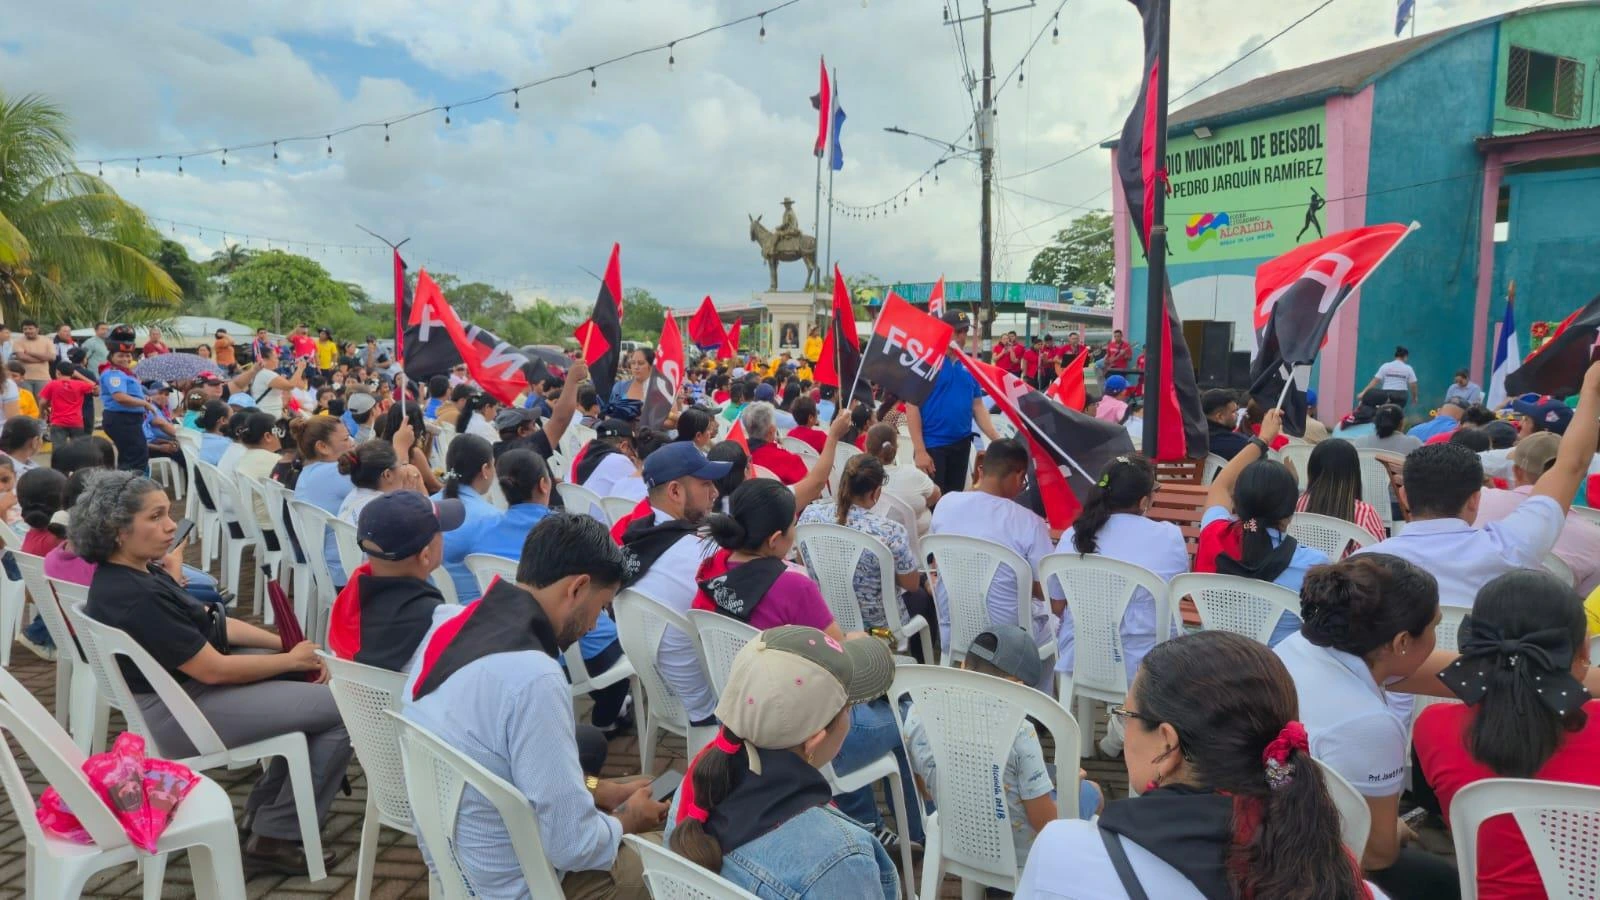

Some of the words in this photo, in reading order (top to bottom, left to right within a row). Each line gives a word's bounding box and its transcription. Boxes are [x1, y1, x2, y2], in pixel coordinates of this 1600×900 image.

[1185, 138, 1248, 173] MUNICIPAL
[1250, 134, 1266, 160] DE
[1270, 123, 1323, 157] BEISBOL
[1173, 177, 1209, 199] PEDRO
[1212, 165, 1261, 193] JARQUÍN
[1264, 157, 1323, 184] RAMÍREZ
